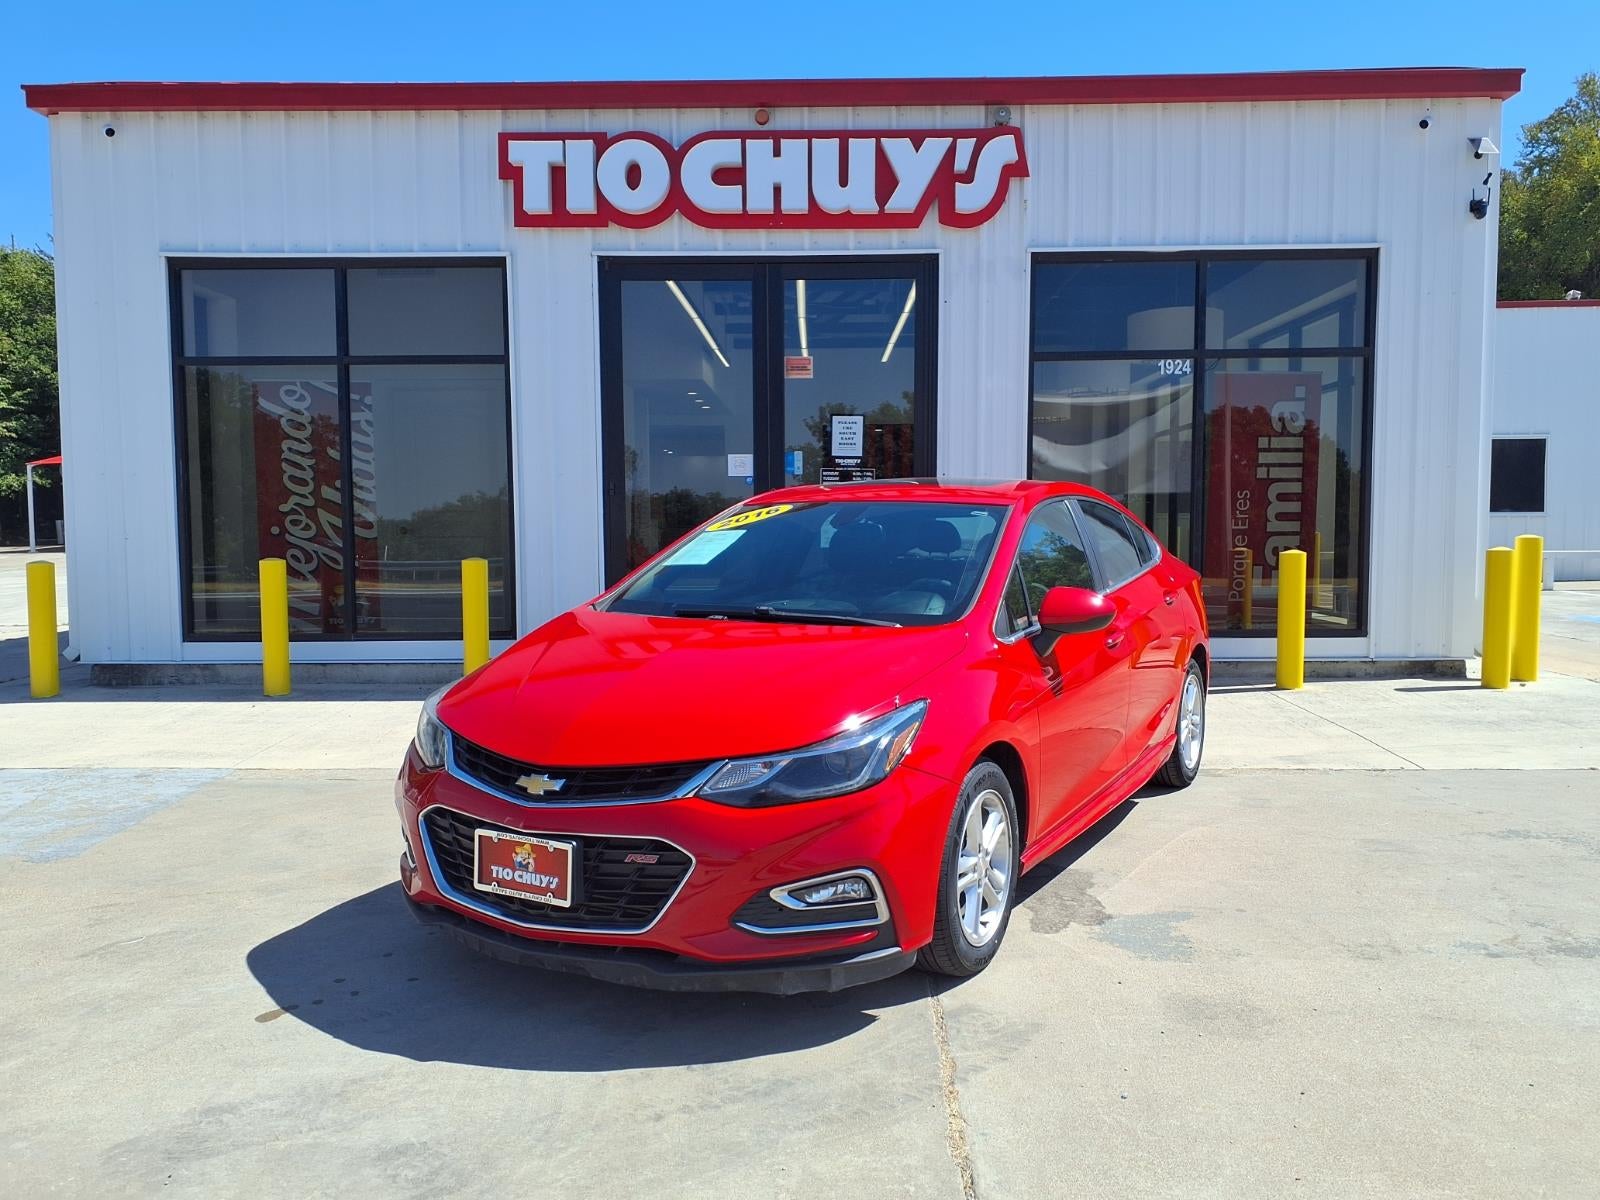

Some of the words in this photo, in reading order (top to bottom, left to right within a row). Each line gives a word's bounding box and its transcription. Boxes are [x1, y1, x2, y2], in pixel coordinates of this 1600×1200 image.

[1157, 359, 1192, 375] 1924
[716, 507, 781, 529] 2016
[1231, 489, 1250, 530] Eres
[1228, 535, 1250, 602] Porque
[624, 853, 660, 864] RS
[490, 865, 513, 881] TIO
[513, 870, 560, 889] CHUY'S
